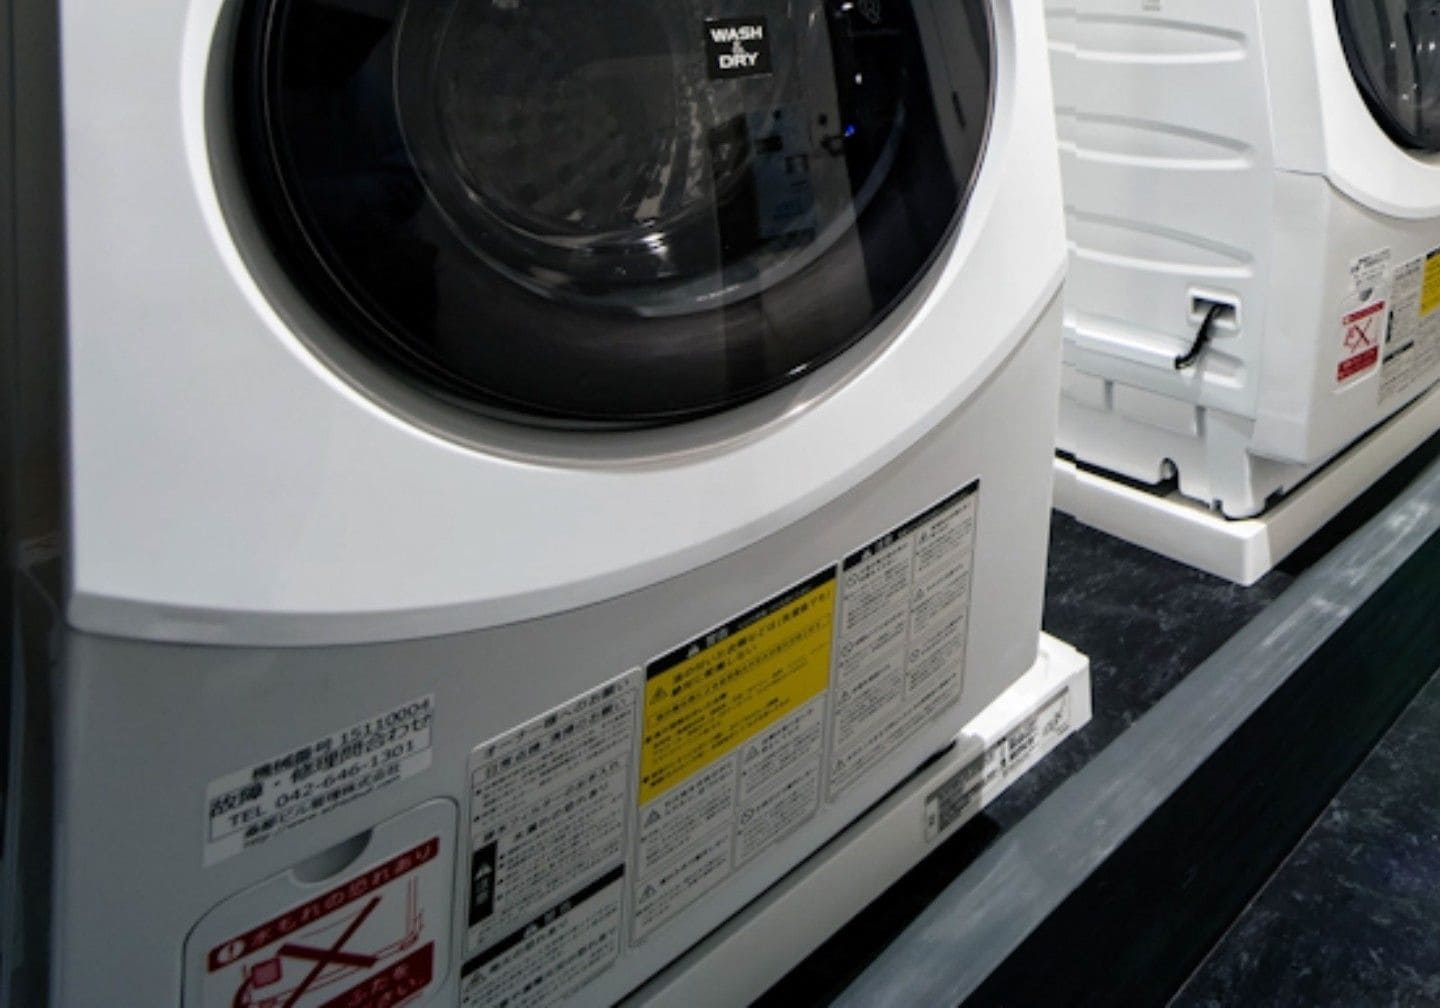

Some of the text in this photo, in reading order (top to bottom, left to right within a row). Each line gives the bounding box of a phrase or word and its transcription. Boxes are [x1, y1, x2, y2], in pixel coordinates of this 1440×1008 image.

[710, 25, 764, 43] WASH
[718, 52, 759, 70] DRY
[229, 801, 264, 829] TEL
